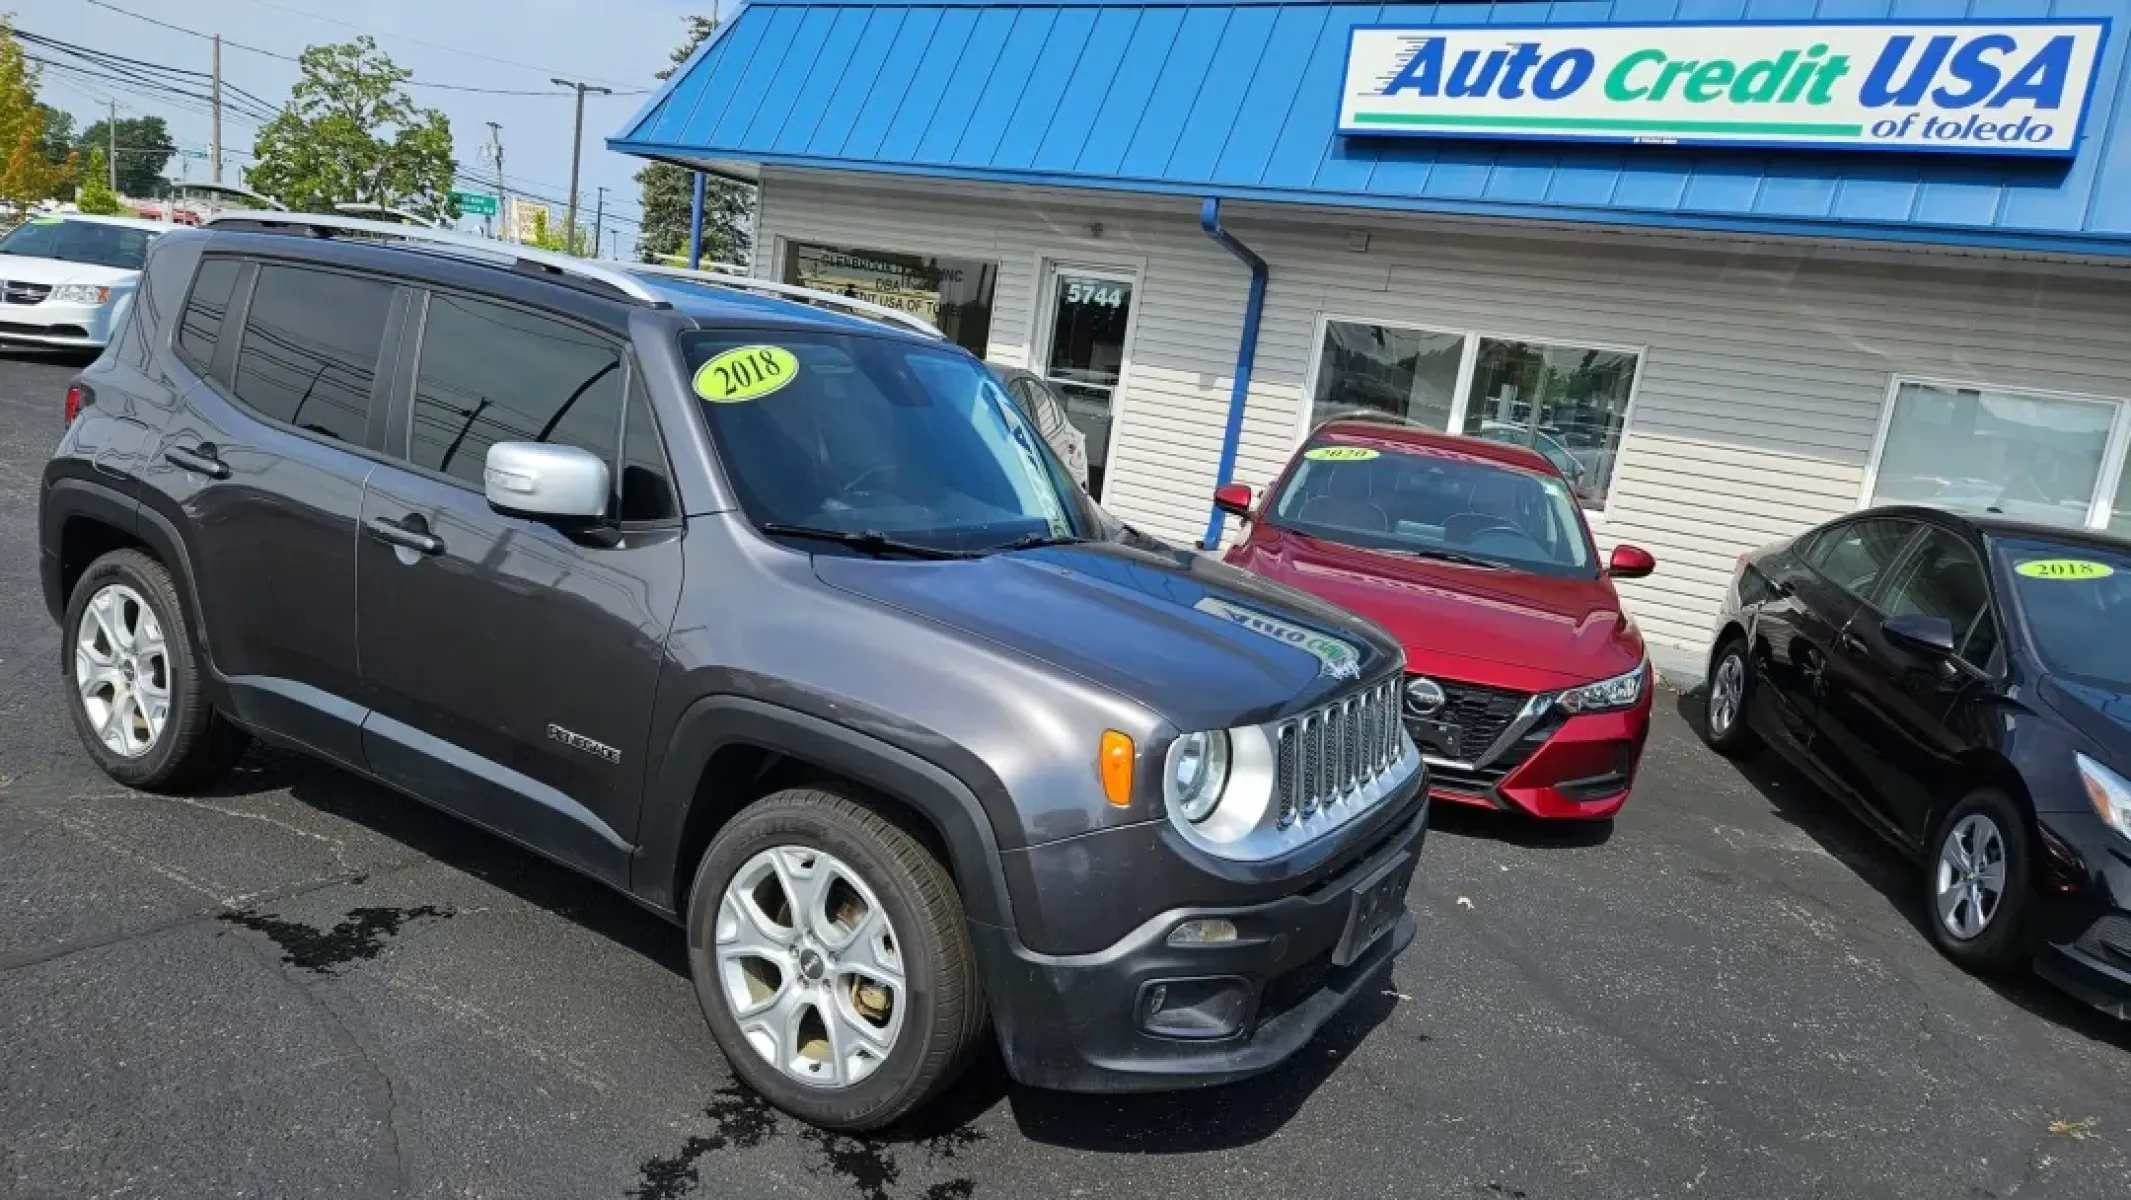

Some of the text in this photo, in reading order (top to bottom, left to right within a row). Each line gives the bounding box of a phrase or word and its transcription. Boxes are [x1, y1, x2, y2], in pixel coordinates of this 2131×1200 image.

[1380, 33, 2076, 109] Auto Credit USA
[1871, 112, 2054, 143] of toledo
[1065, 283, 1122, 309] 5744
[713, 350, 781, 397] 2018
[2035, 563, 2095, 575] 2018
